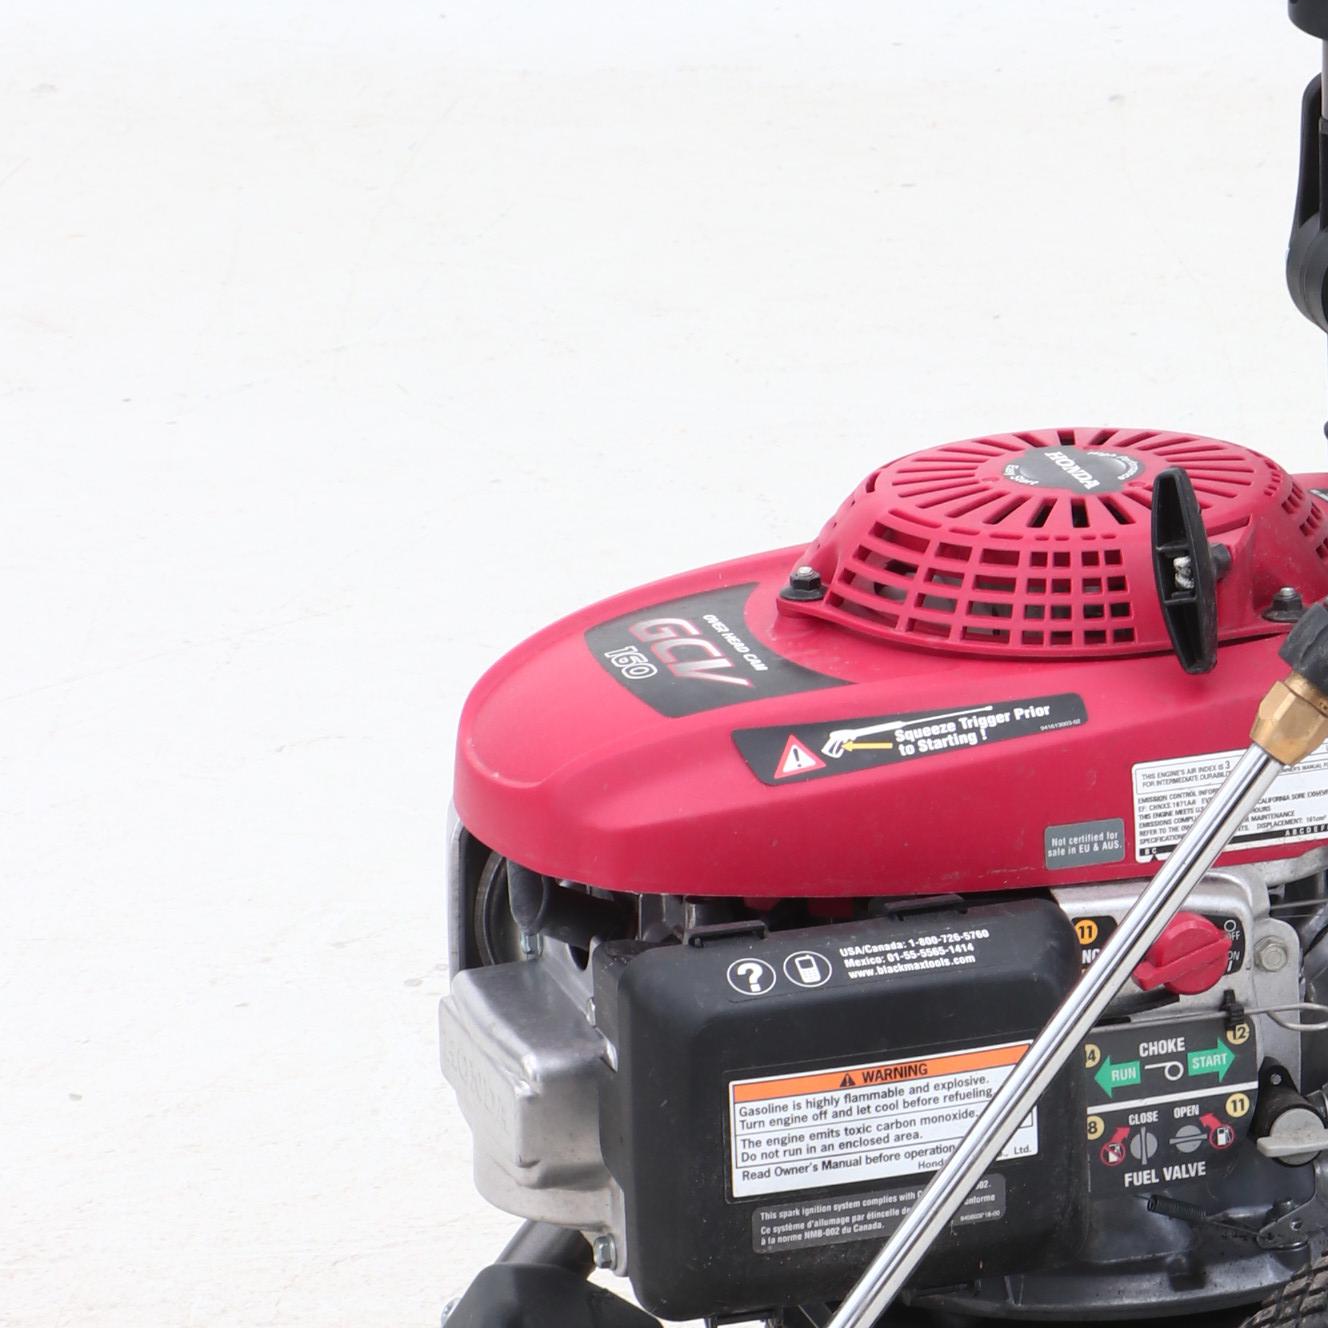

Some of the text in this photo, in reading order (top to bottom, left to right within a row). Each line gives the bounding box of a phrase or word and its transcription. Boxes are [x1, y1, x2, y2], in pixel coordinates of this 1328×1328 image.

[1044, 451, 1101, 491] HONDA
[628, 616, 754, 688] GCV
[702, 614, 769, 671] OVER HEAD CAM
[603, 645, 658, 680] 160
[894, 705, 1050, 742] Squeeze Trigger Prior
[898, 727, 987, 756] to Starting !
[1156, 769, 1185, 779] ENGINE'S
[1197, 765, 1216, 773] INDEX
[1224, 760, 1231, 769] 3
[1047, 839, 1122, 857] sale in EU & AUS.
[1051, 831, 1118, 847] Not certified for
[1078, 924, 1093, 940] 11
[839, 941, 907, 957] USA/Canada:
[843, 955, 885, 968] Mexico:
[847, 954, 976, 979] www.blackmaxtools.com
[1230, 1025, 1248, 1041] 12
[1139, 1036, 1185, 1057] CHOKE
[1191, 1052, 1227, 1069] START
[861, 1063, 928, 1083] WARNING
[1111, 1066, 1136, 1081] RUN
[738, 1075, 989, 1117] Gasoline is highly flammable and explosive.
[1230, 1097, 1246, 1113] 11
[739, 1119, 765, 1130] Turn
[768, 1113, 808, 1127] engine
[811, 1108, 827, 1121] off
[831, 1105, 853, 1119] and
[856, 1104, 871, 1115] let
[874, 1099, 899, 1113] cool
[902, 1096, 939, 1109] before
[1128, 1110, 1158, 1125] CLOSE
[1173, 1104, 1199, 1119] OPEN
[740, 1108, 978, 1149] The engine emits toxic carbon monoxide.
[1086, 1120, 1099, 1135] 8
[740, 1131, 923, 1163] Do not run in an enclosed area.
[1013, 1144, 1031, 1155] Ltd.
[741, 1167, 771, 1181] Read
[774, 1162, 818, 1177] Owner's
[821, 1155, 862, 1171] Manual
[865, 1152, 901, 1165] before
[1124, 1161, 1206, 1187] FUEL VALVE
[759, 1191, 916, 1221] This spark ignition system complies with
[767, 1236, 776, 1244] la
[777, 1233, 802, 1243] norme
[803, 1226, 840, 1239] NMB-002
[841, 1225, 851, 1234] du
[852, 1221, 884, 1233] Canada.
